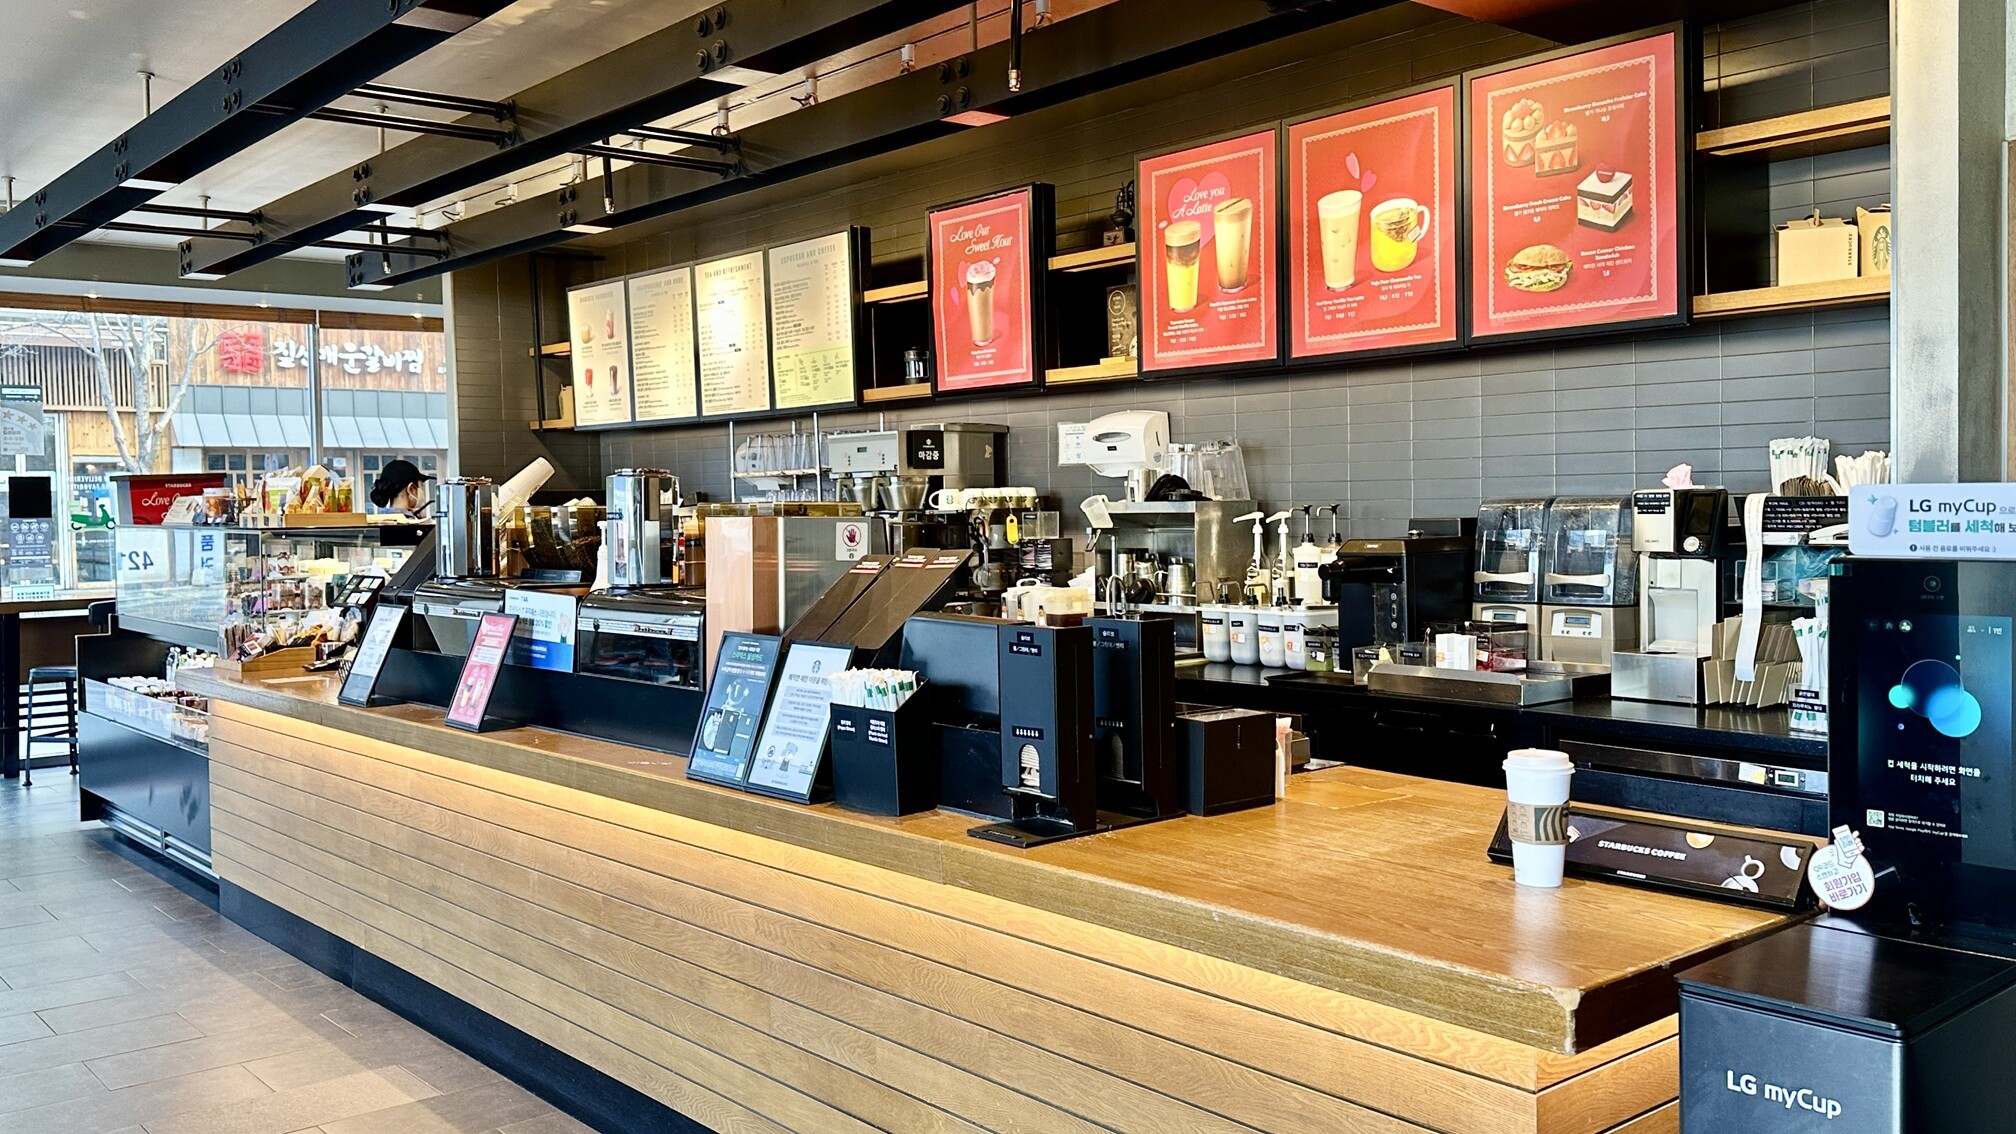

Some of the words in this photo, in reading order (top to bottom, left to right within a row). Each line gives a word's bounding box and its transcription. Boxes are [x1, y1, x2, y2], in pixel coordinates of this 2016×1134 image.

[1183, 187, 1208, 203] Love
[1209, 186, 1226, 200] you
[1186, 201, 1212, 216] Latte
[949, 224, 975, 243] Love
[974, 223, 991, 238] Our
[965, 237, 990, 255] Sweet
[990, 234, 1013, 250] Hour
[918, 450, 940, 461] 마감중
[141, 491, 170, 507] Love
[1909, 499, 1932, 513] LG
[1938, 499, 1997, 516] myCup
[1908, 519, 1961, 533] 텀블러를
[1964, 519, 2006, 534] 세척해
[1919, 544, 1931, 552] 사용
[1887, 758, 1894, 768] 컵
[1896, 760, 1918, 771] 세척을
[1920, 762, 1956, 775] 시작하려면
[1958, 766, 1982, 778] 화면을
[1910, 774, 1932, 784] 터치해
[1934, 776, 1956, 786] 주세요
[1597, 839, 1651, 856] STARBUCKS
[1650, 846, 1687, 861] COFFEE
[1813, 860, 1836, 873] QR코드
[1816, 868, 1840, 881] 스캔하고
[1823, 872, 1862, 893] 회원가입
[1828, 883, 1868, 904] 바로가기
[1727, 1069, 1757, 1096] LG
[1764, 1084, 1842, 1120] myCup
